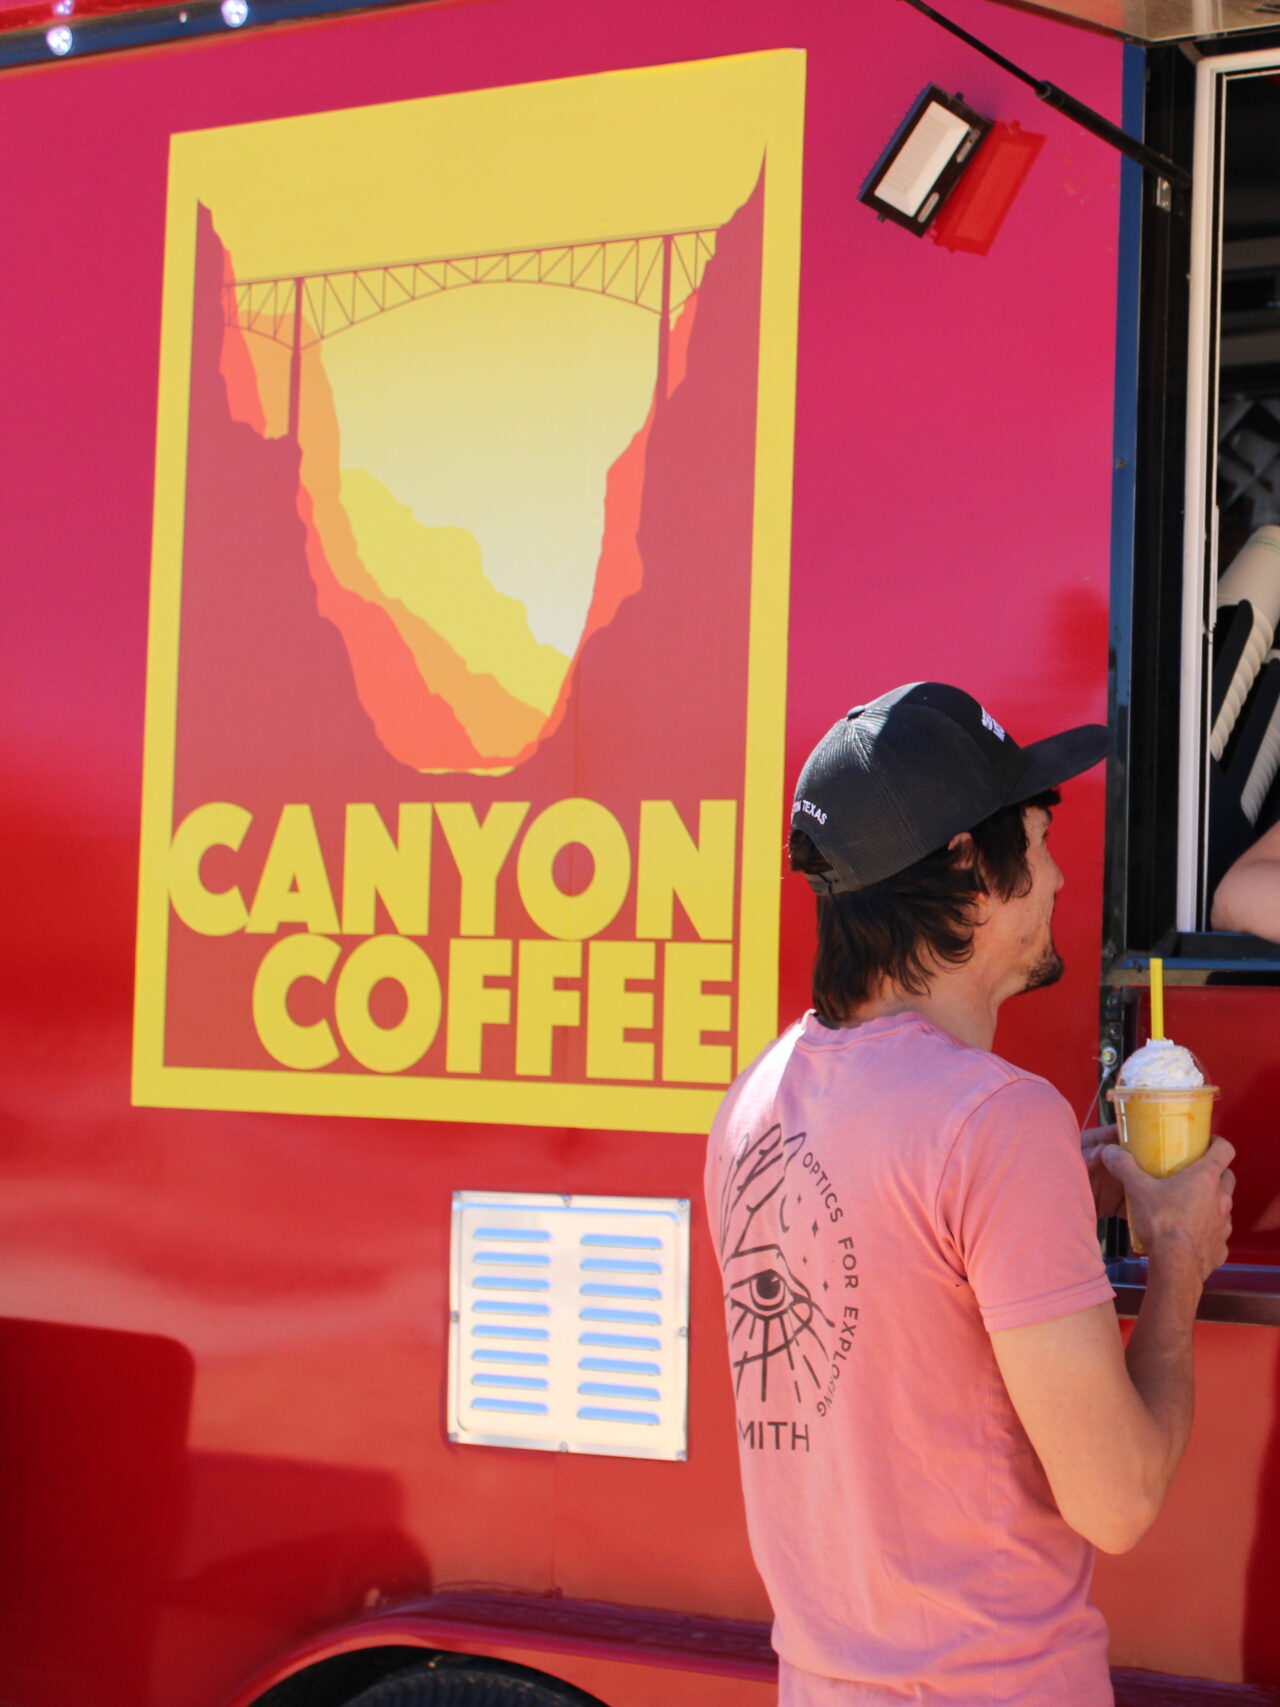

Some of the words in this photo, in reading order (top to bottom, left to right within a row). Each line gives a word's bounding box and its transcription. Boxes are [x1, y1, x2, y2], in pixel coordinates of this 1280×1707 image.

[168, 797, 736, 941] CANYON
[802, 799, 828, 825] TEXAS
[252, 933, 733, 1084] COFFEE
[802, 1152, 844, 1223] OPTICS
[838, 1236, 860, 1289] FOR
[738, 1419, 809, 1452] MITH
